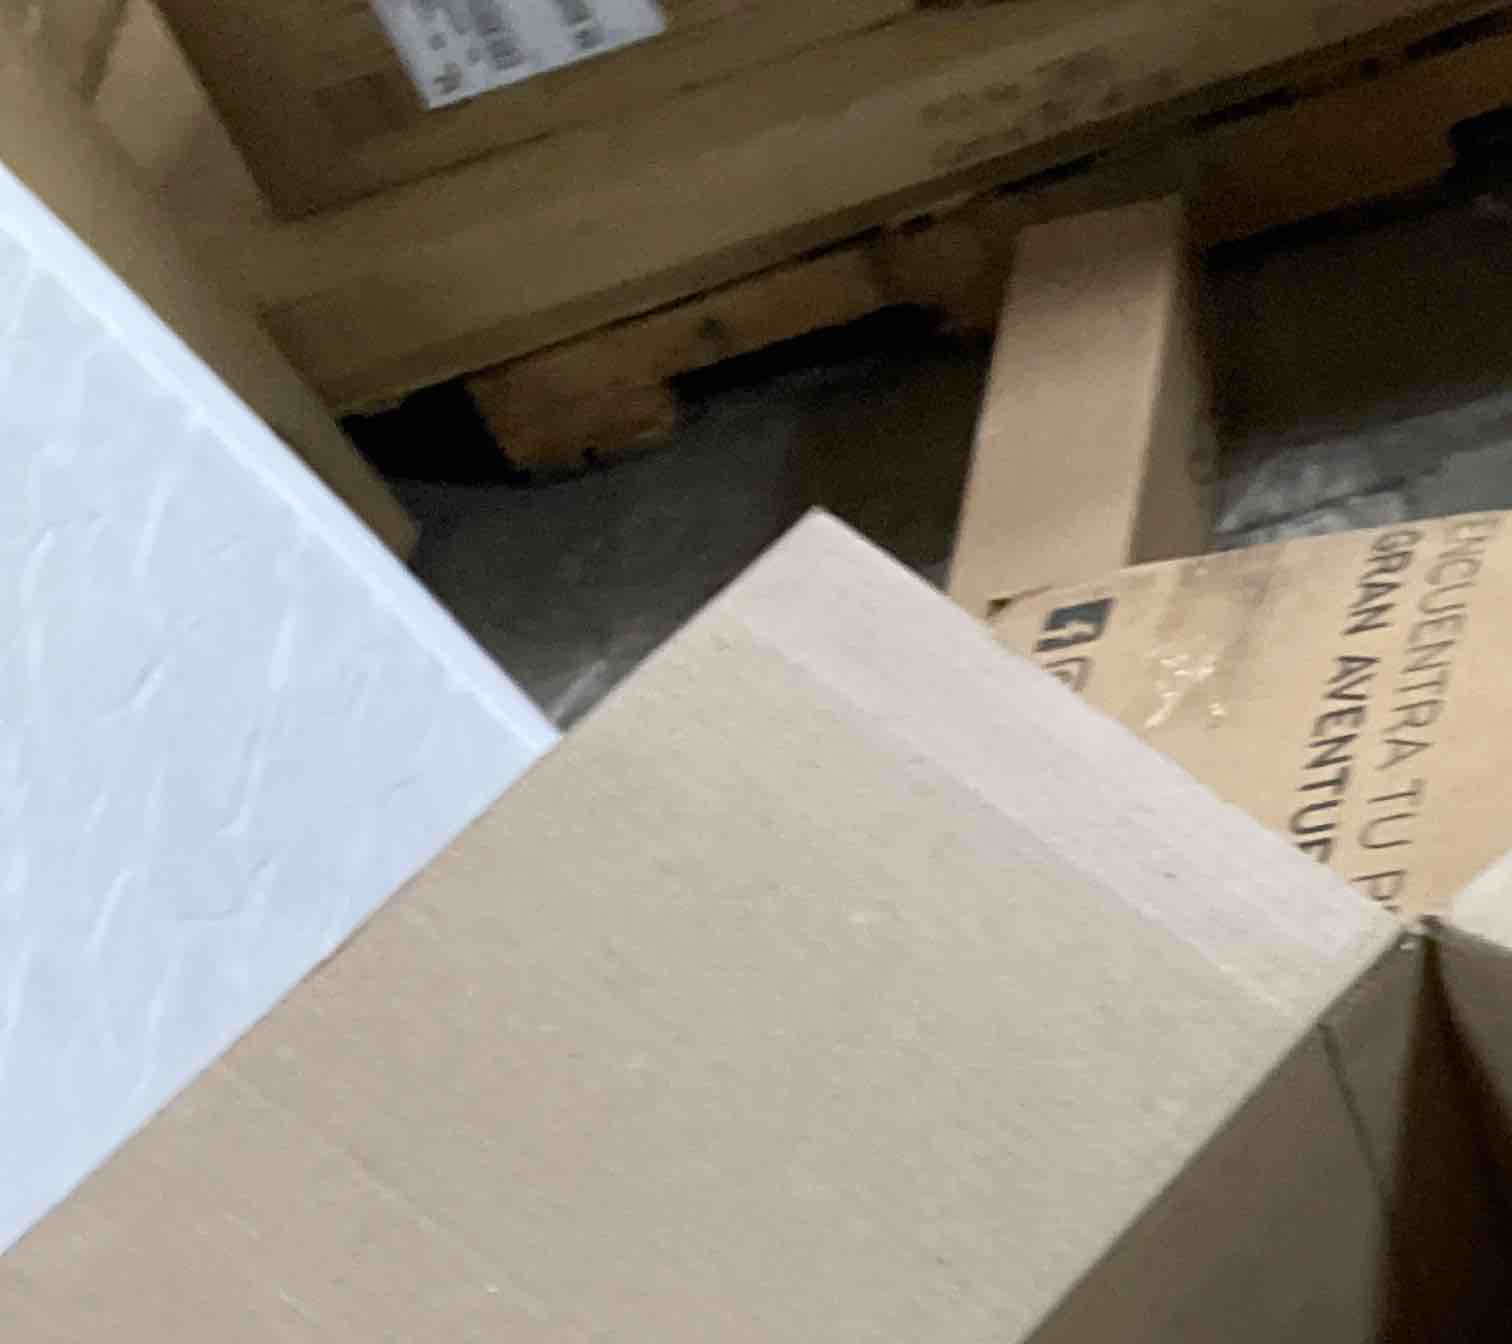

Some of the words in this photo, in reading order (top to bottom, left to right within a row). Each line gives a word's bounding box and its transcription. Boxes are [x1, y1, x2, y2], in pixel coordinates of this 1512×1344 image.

[1342, 528, 1422, 635] GRAN
[1377, 518, 1498, 770] ENCUENTRA
[1358, 778, 1427, 852] TU
